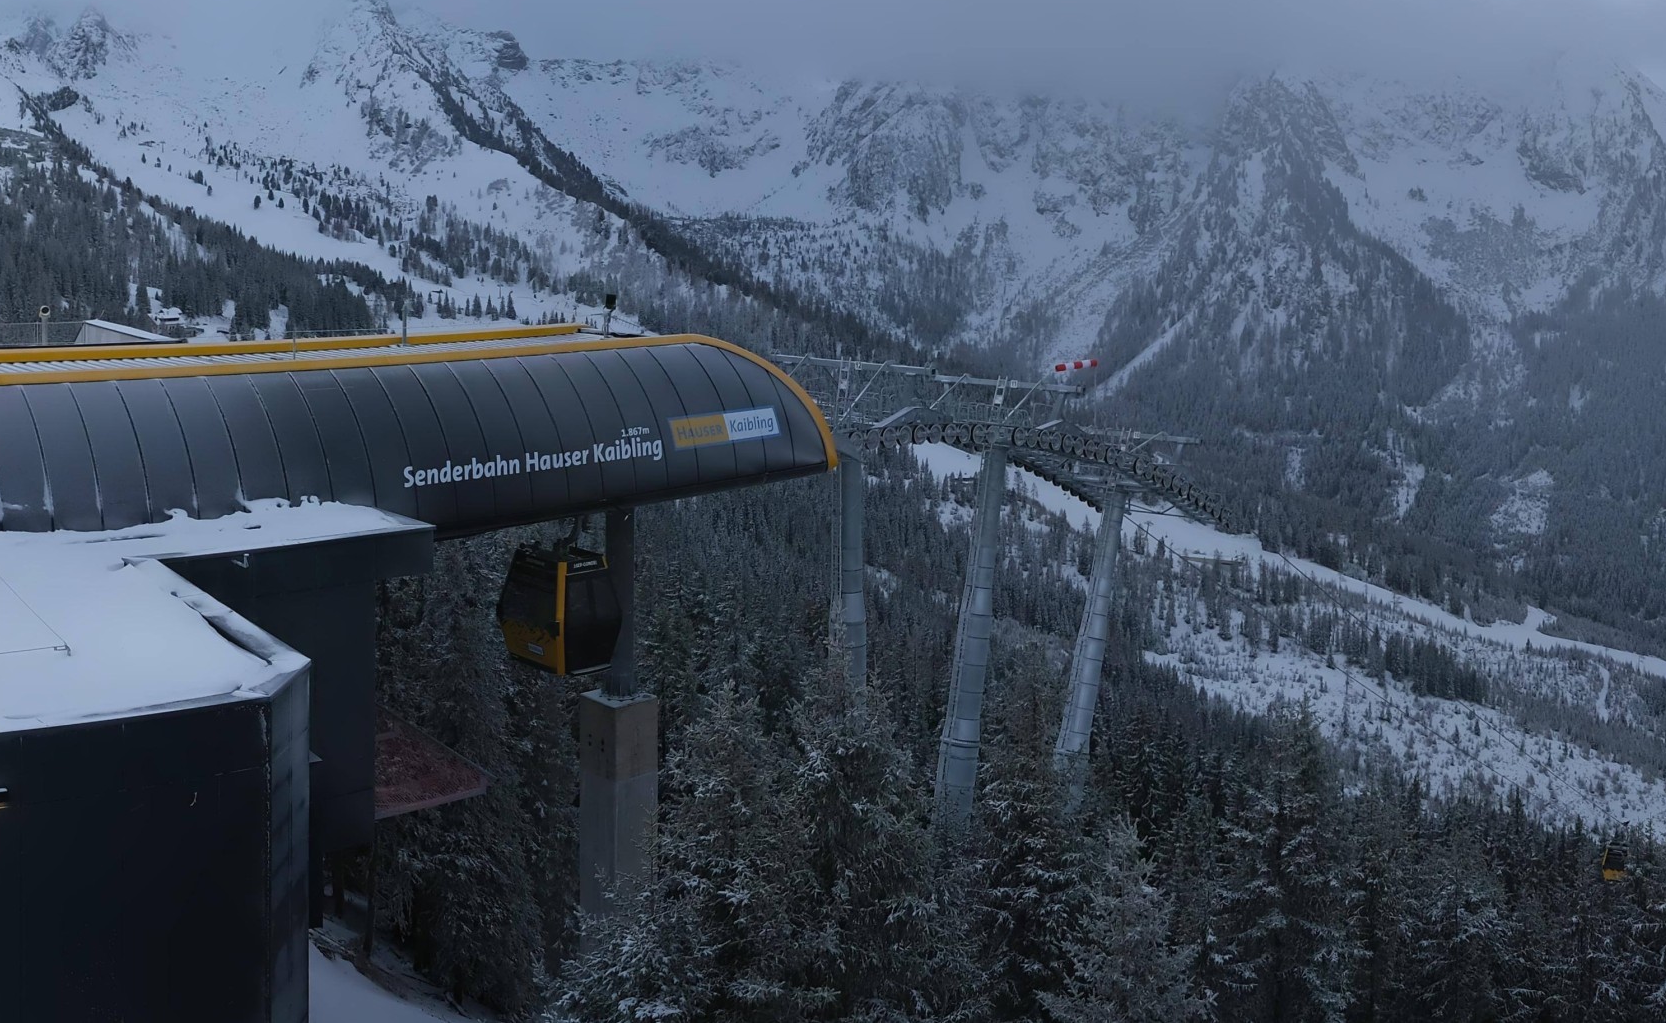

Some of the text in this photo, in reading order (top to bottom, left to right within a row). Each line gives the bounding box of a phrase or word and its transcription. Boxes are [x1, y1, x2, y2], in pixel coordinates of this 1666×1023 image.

[621, 426, 650, 437] 1.867m
[676, 416, 775, 440] HAUSER Kaibling
[403, 437, 664, 488] Senderbahn Hauser Kaibling
